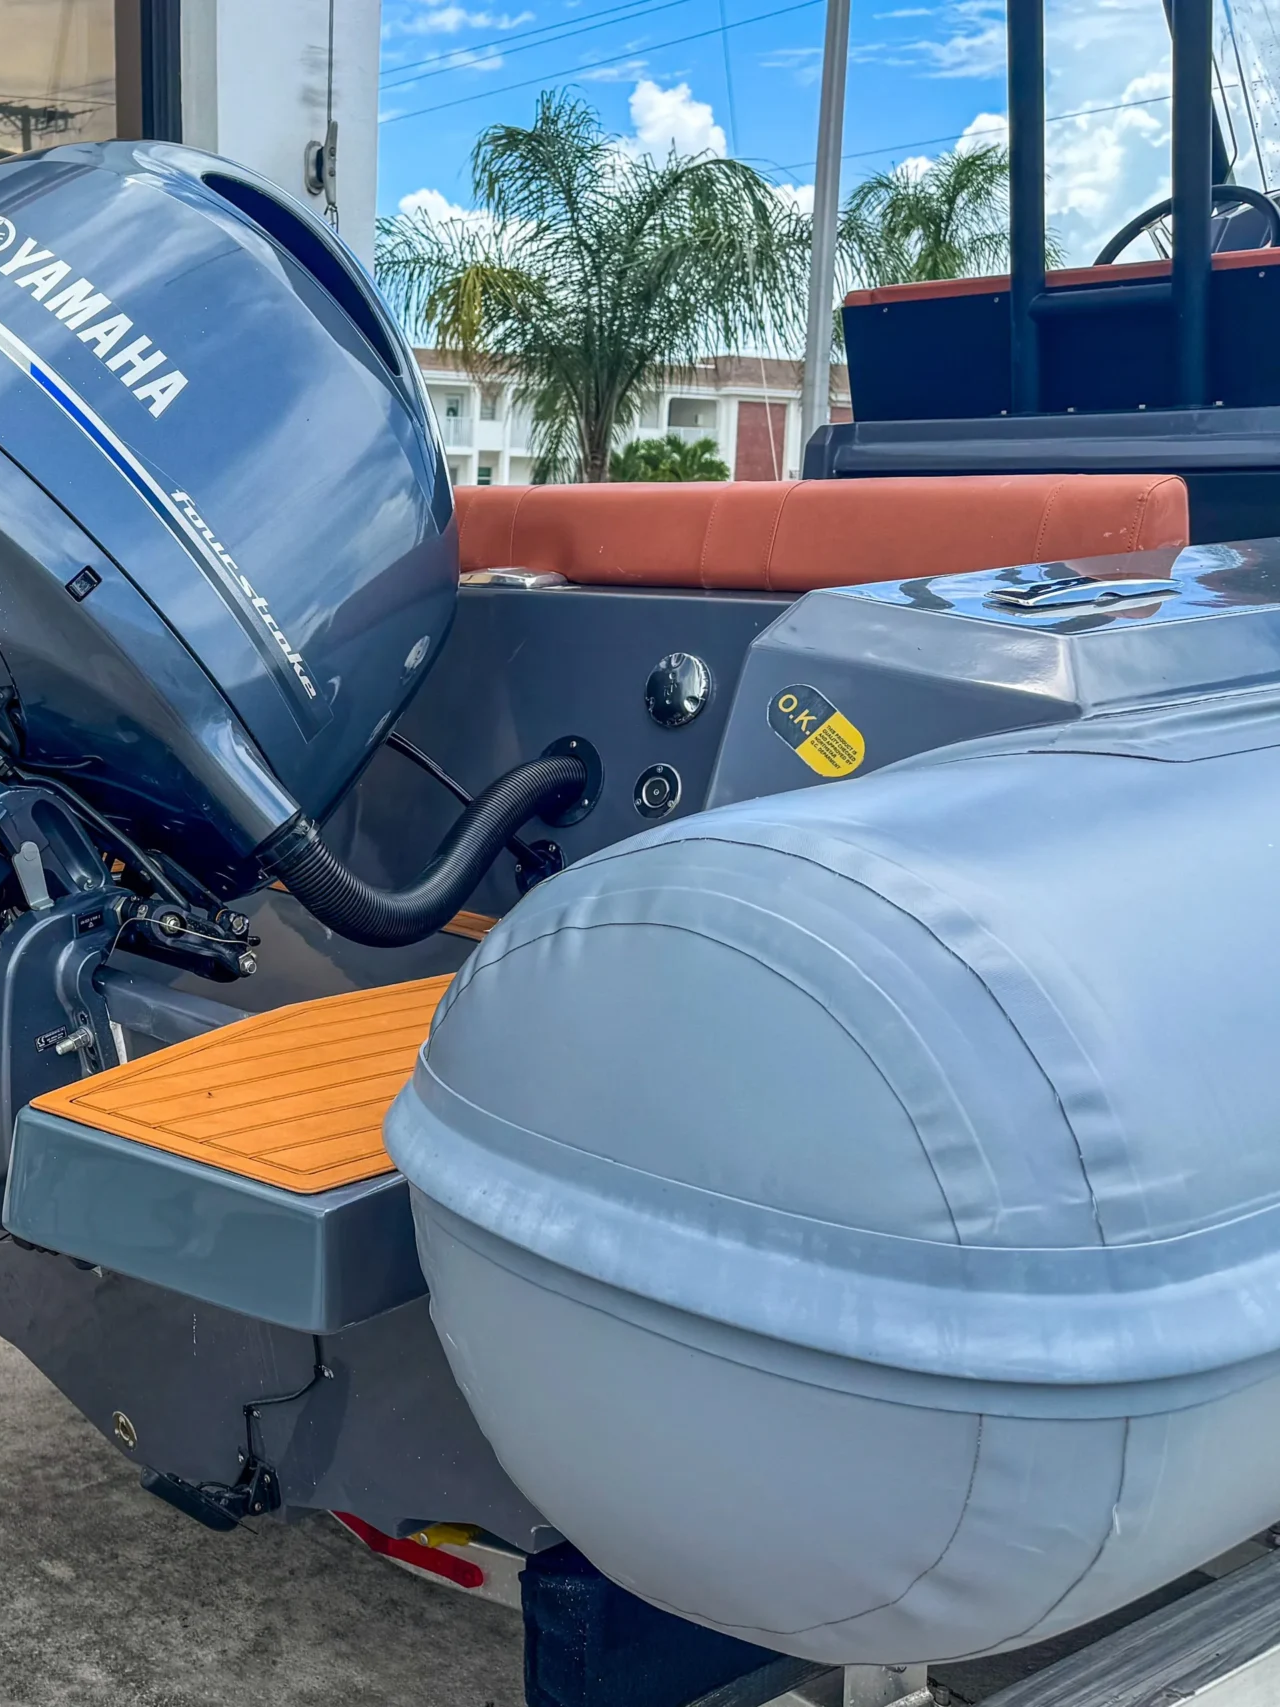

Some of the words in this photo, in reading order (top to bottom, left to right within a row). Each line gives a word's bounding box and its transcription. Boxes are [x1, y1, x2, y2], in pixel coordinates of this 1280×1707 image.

[778, 694, 817, 735] O.K.
[814, 736, 837, 758] NORTHSTAR
[819, 733, 827, 742] AND
[826, 740, 847, 760] APPROVED
[822, 729, 839, 744] QUALITY
[838, 743, 856, 762] CHECKED
[835, 733, 853, 751] PRODUCT
